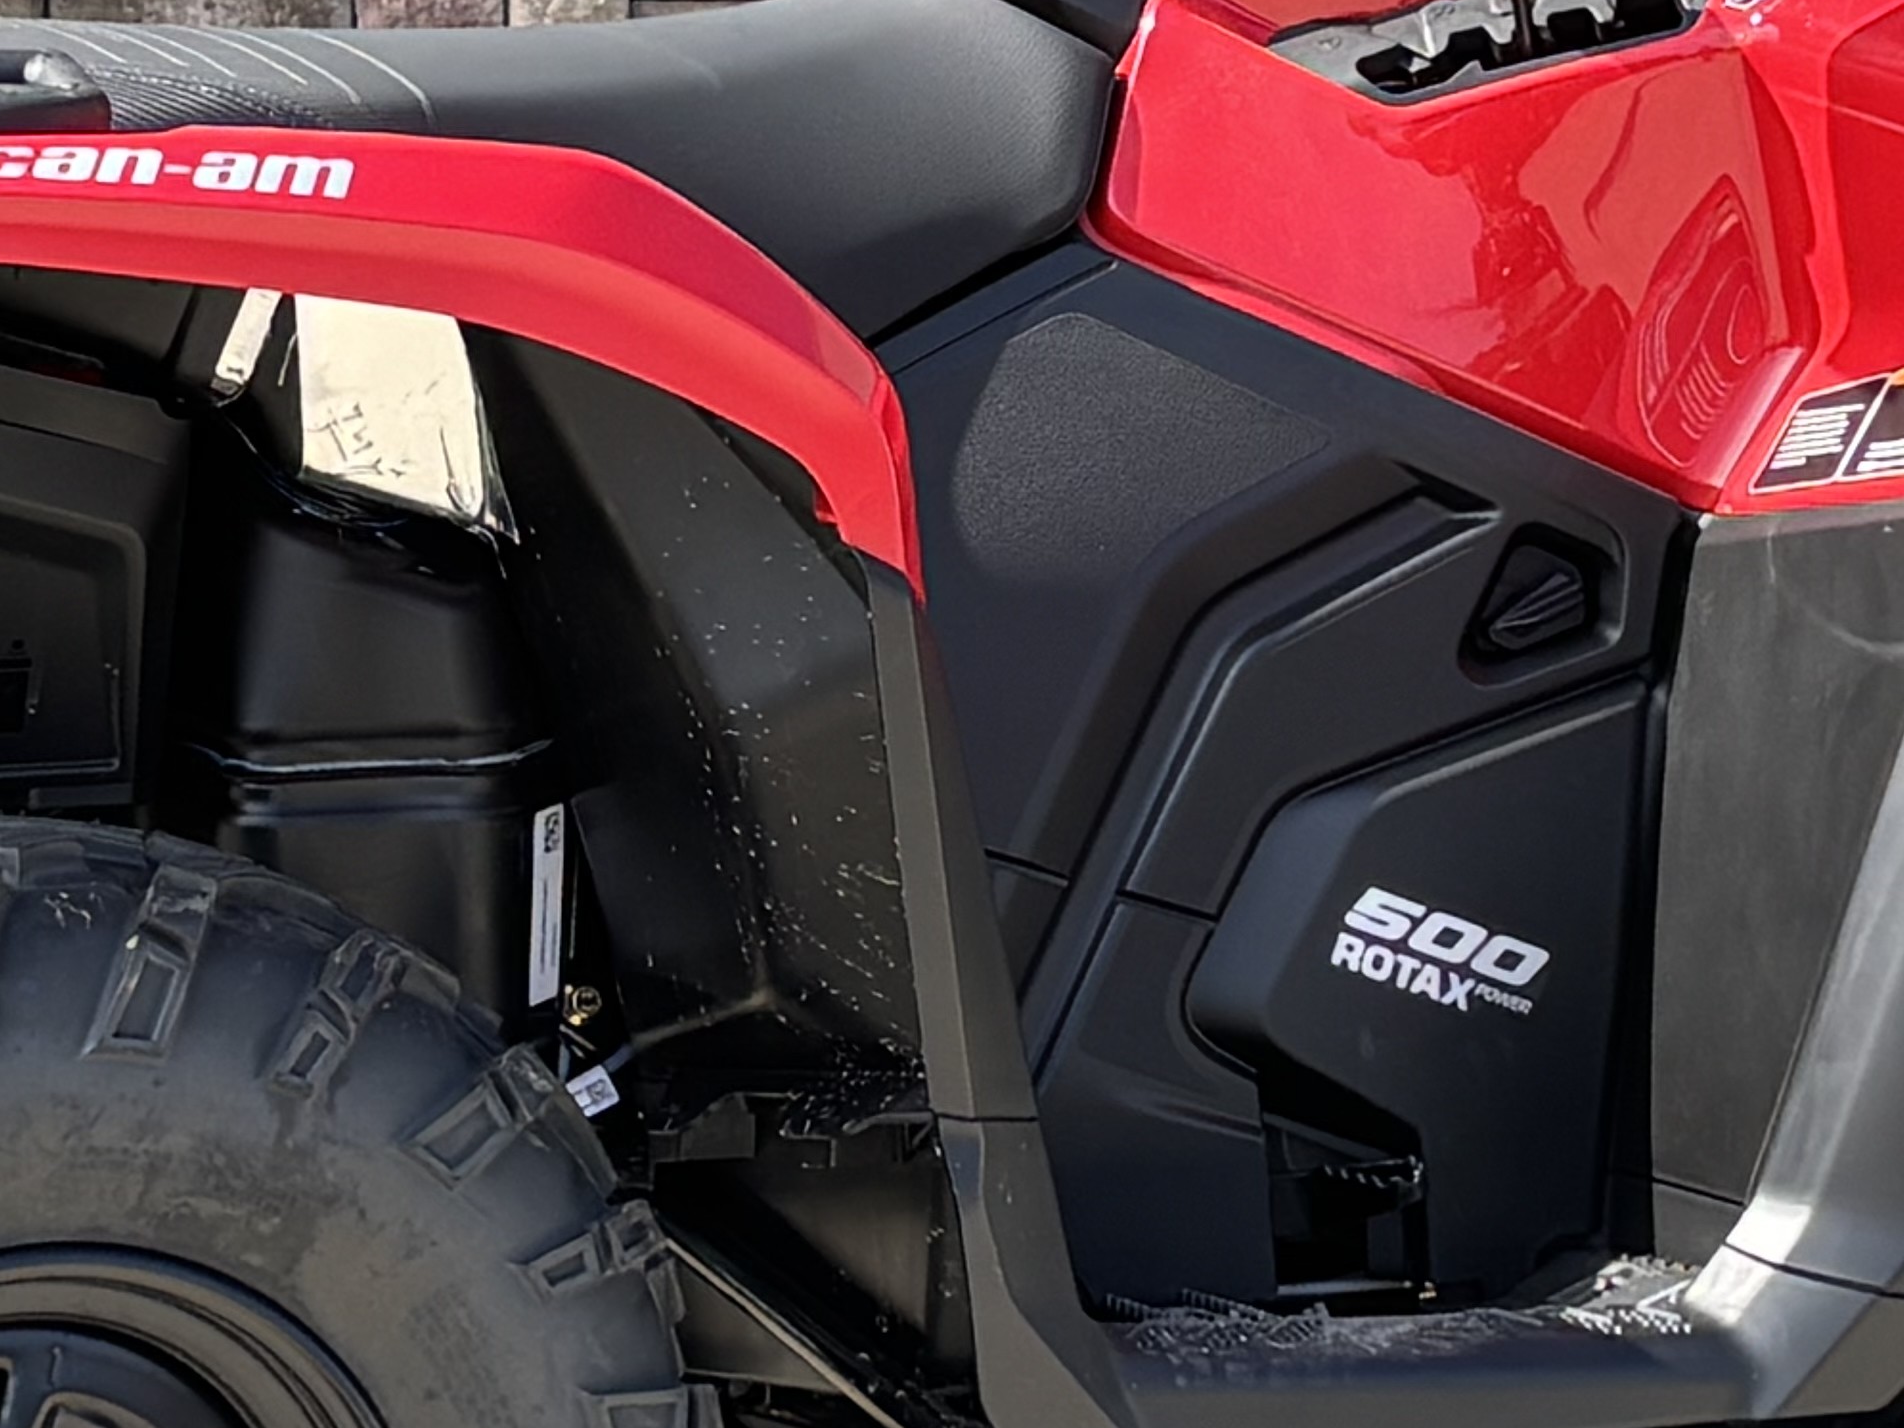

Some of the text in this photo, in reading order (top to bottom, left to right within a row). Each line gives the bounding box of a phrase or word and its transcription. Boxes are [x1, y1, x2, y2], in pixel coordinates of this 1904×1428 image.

[1331, 931, 1533, 1015] ROTAX POWER
[1345, 886, 1550, 987] 500
